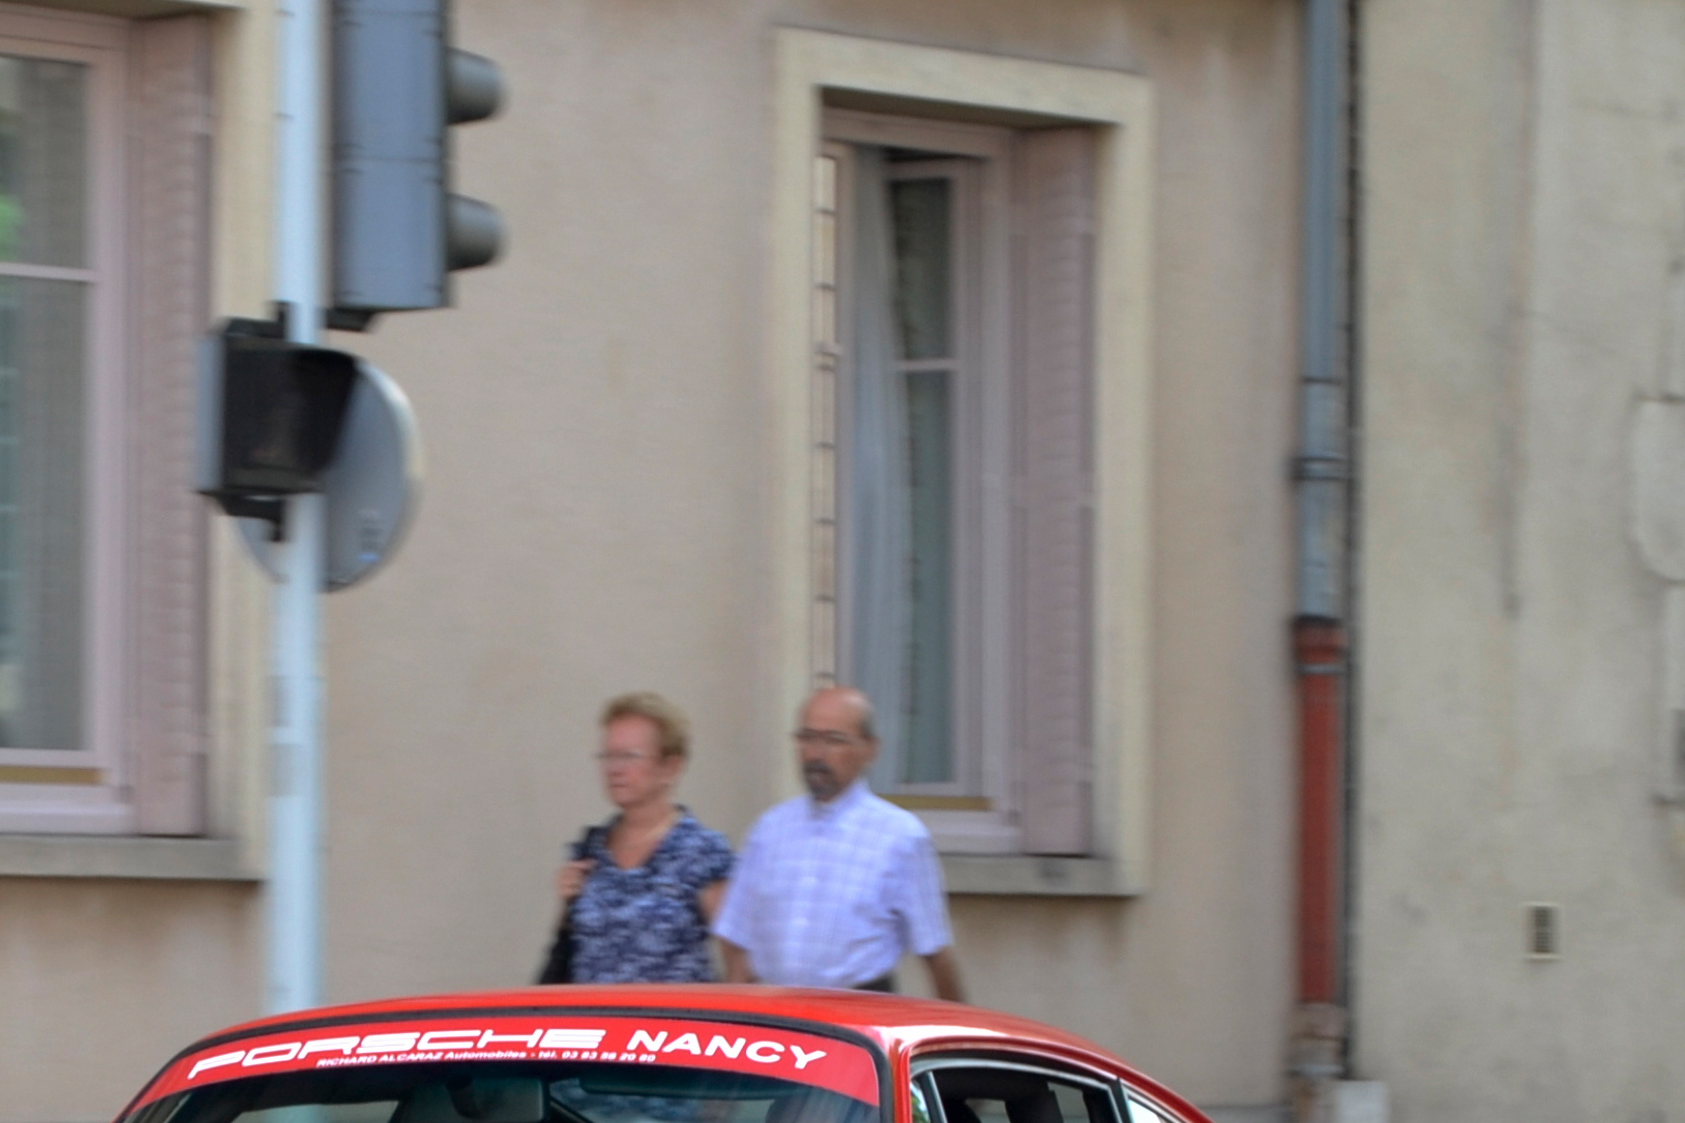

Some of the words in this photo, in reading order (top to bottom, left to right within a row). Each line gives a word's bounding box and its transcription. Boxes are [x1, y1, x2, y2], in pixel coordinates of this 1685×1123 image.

[187, 1029, 606, 1079] PORSCHE
[626, 1030, 827, 1069] NANCY
[316, 1054, 376, 1067] RICHARD
[379, 1051, 443, 1063] ALCARAZ
[444, 1051, 527, 1060] Automobiles
[561, 1051, 578, 1059] 03
[619, 1053, 636, 1061] 20
